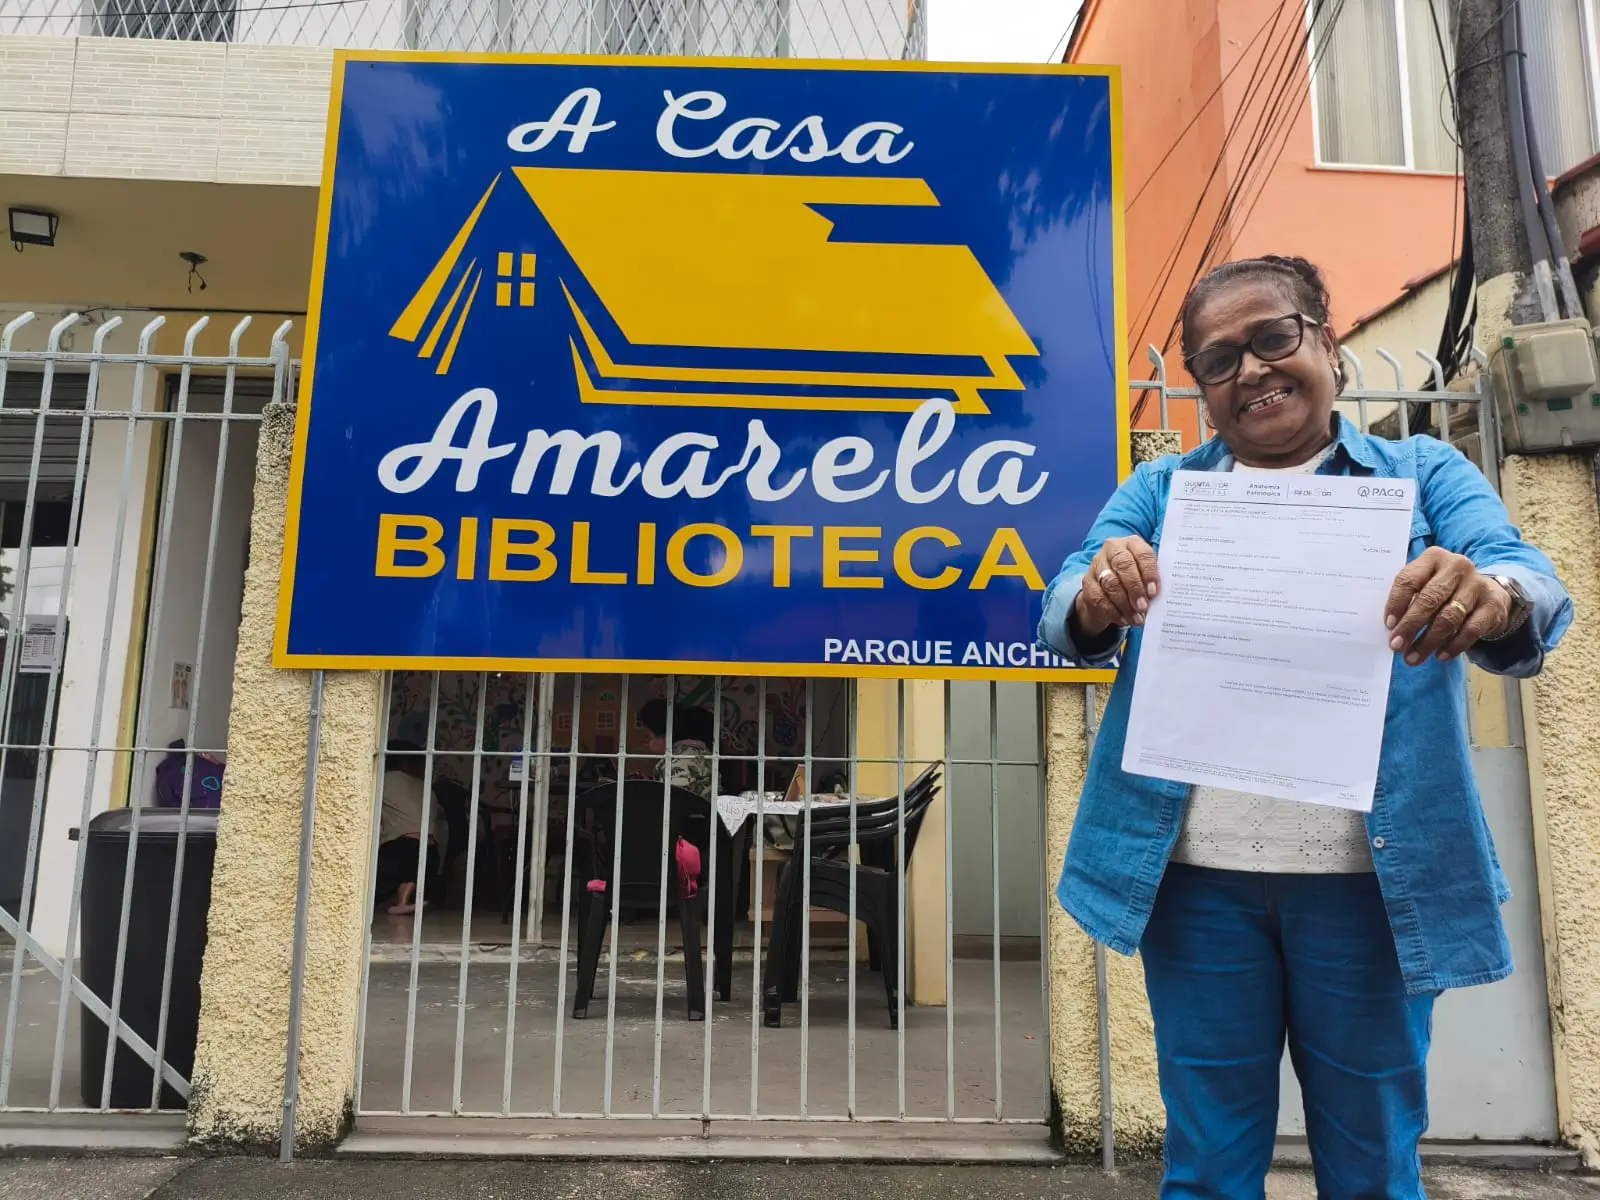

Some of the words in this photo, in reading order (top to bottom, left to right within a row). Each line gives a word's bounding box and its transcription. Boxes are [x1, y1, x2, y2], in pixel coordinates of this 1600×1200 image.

[507, 87, 617, 154] A
[655, 89, 915, 165] Casa
[376, 387, 1050, 506] Amarela
[1371, 487, 1405, 499] PACQ
[374, 512, 1048, 592] BIBLIOTECA
[823, 638, 953, 665] PARQUE
[961, 641, 1121, 668] ANCHI
